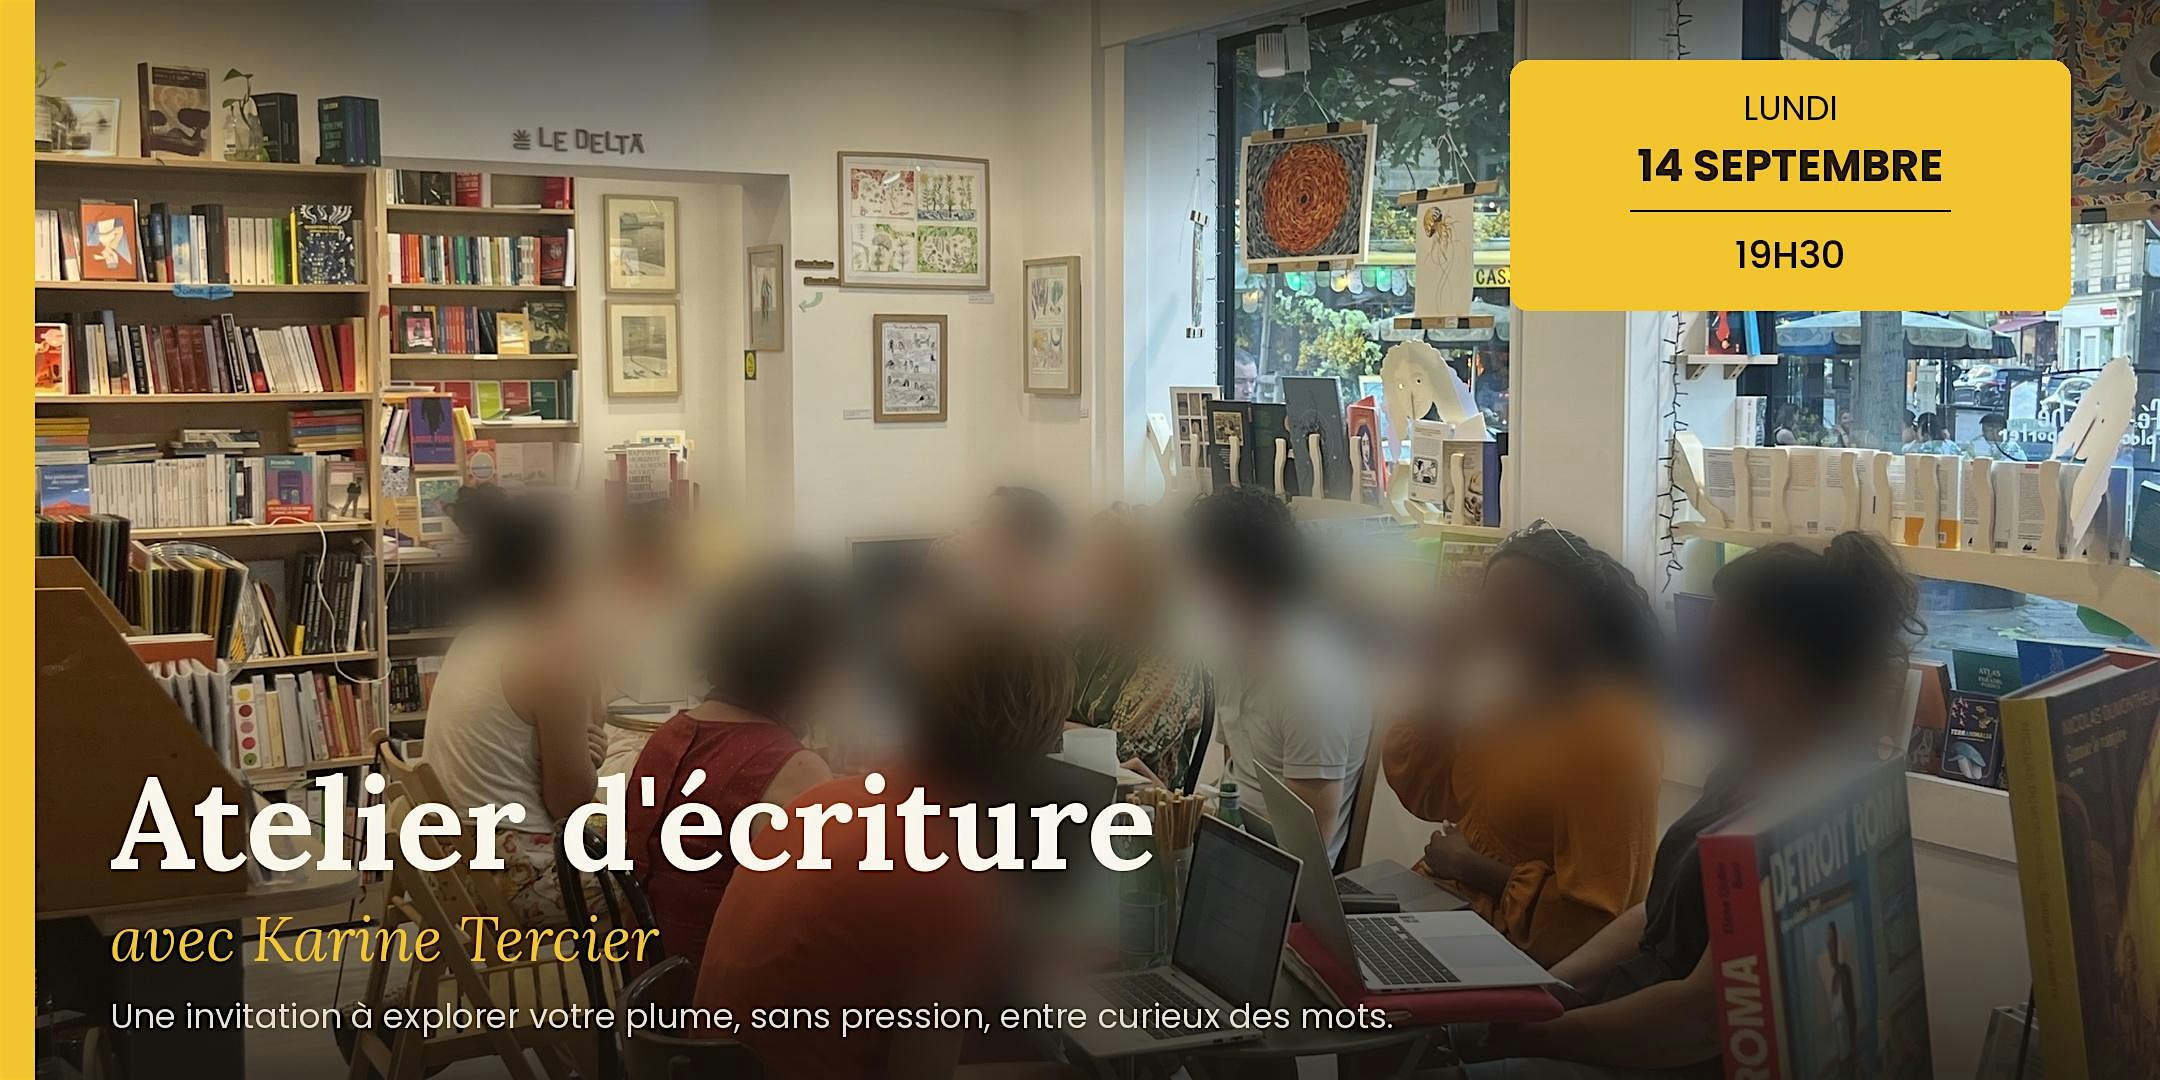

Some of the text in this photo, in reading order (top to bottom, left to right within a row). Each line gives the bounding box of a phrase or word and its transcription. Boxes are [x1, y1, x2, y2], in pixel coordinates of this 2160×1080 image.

[538, 126, 646, 155] LE DELTA
[1475, 268, 1510, 285] CAS
[1769, 810, 1849, 911] DETROIT
